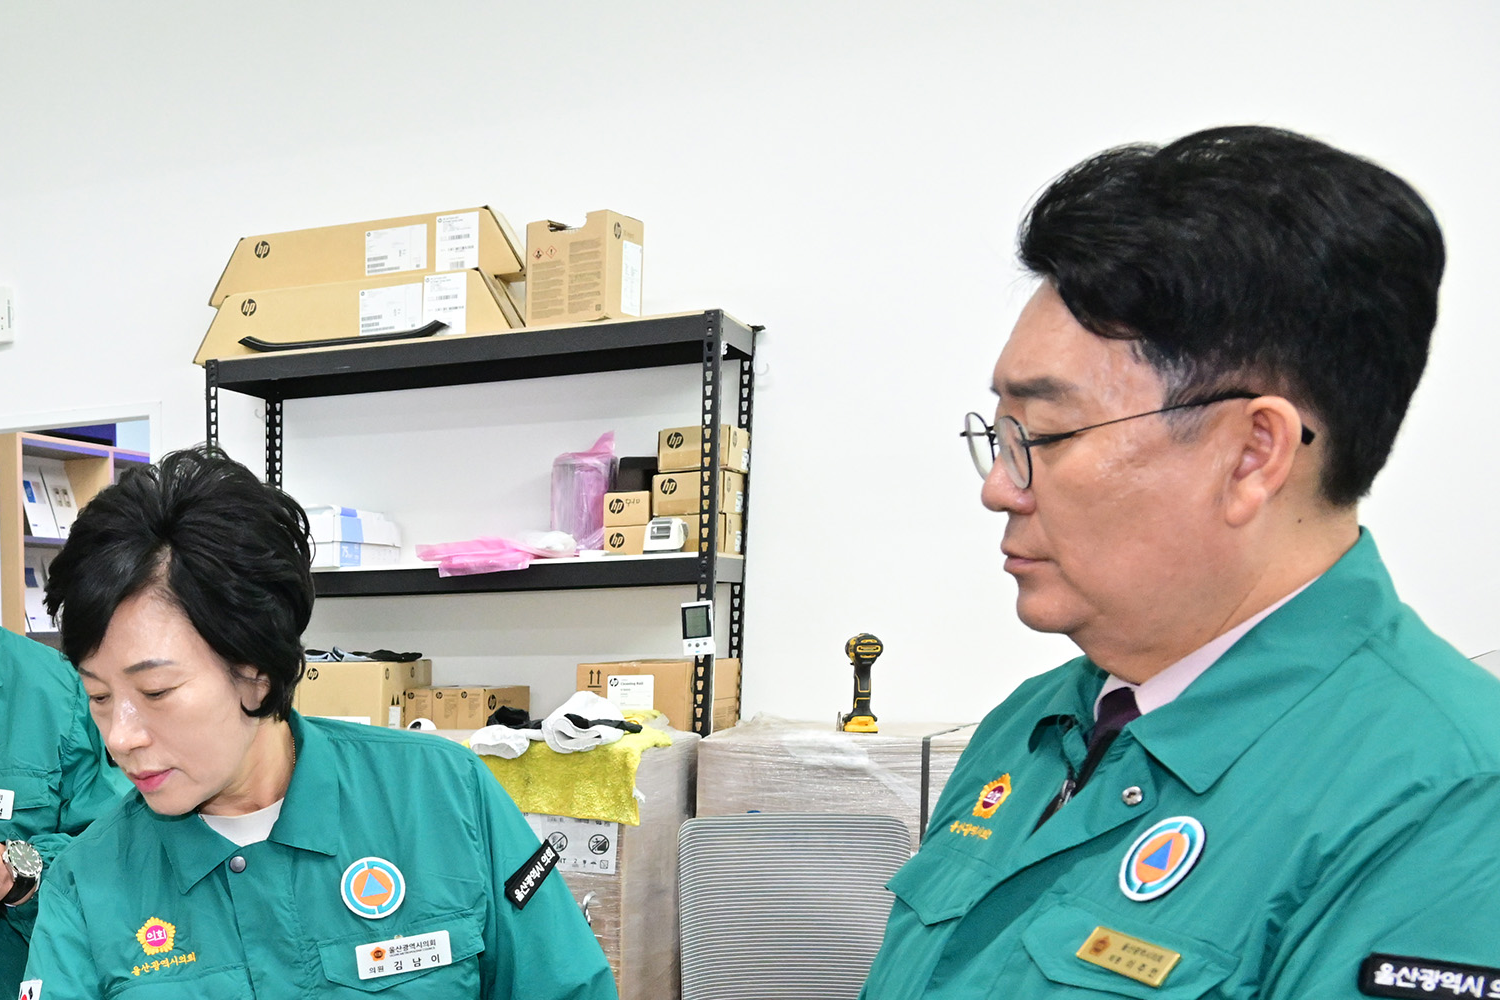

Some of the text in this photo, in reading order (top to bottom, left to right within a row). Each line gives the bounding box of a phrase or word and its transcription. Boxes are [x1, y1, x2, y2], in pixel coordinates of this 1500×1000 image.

[255, 241, 270, 258] hp
[241, 299, 257, 317] hp
[667, 432, 684, 449] hp
[660, 478, 677, 495] hp
[609, 499, 624, 514] hp
[609, 533, 625, 548] hp
[514, 861, 545, 902] 울산광역시
[541, 846, 556, 866] 의회
[146, 928, 167, 942] 의회
[388, 939, 437, 954] 울산광역시의회
[131, 951, 197, 976] 울산광역시의회
[368, 965, 384, 974] 의원
[1374, 962, 1485, 999] 울산광역시
